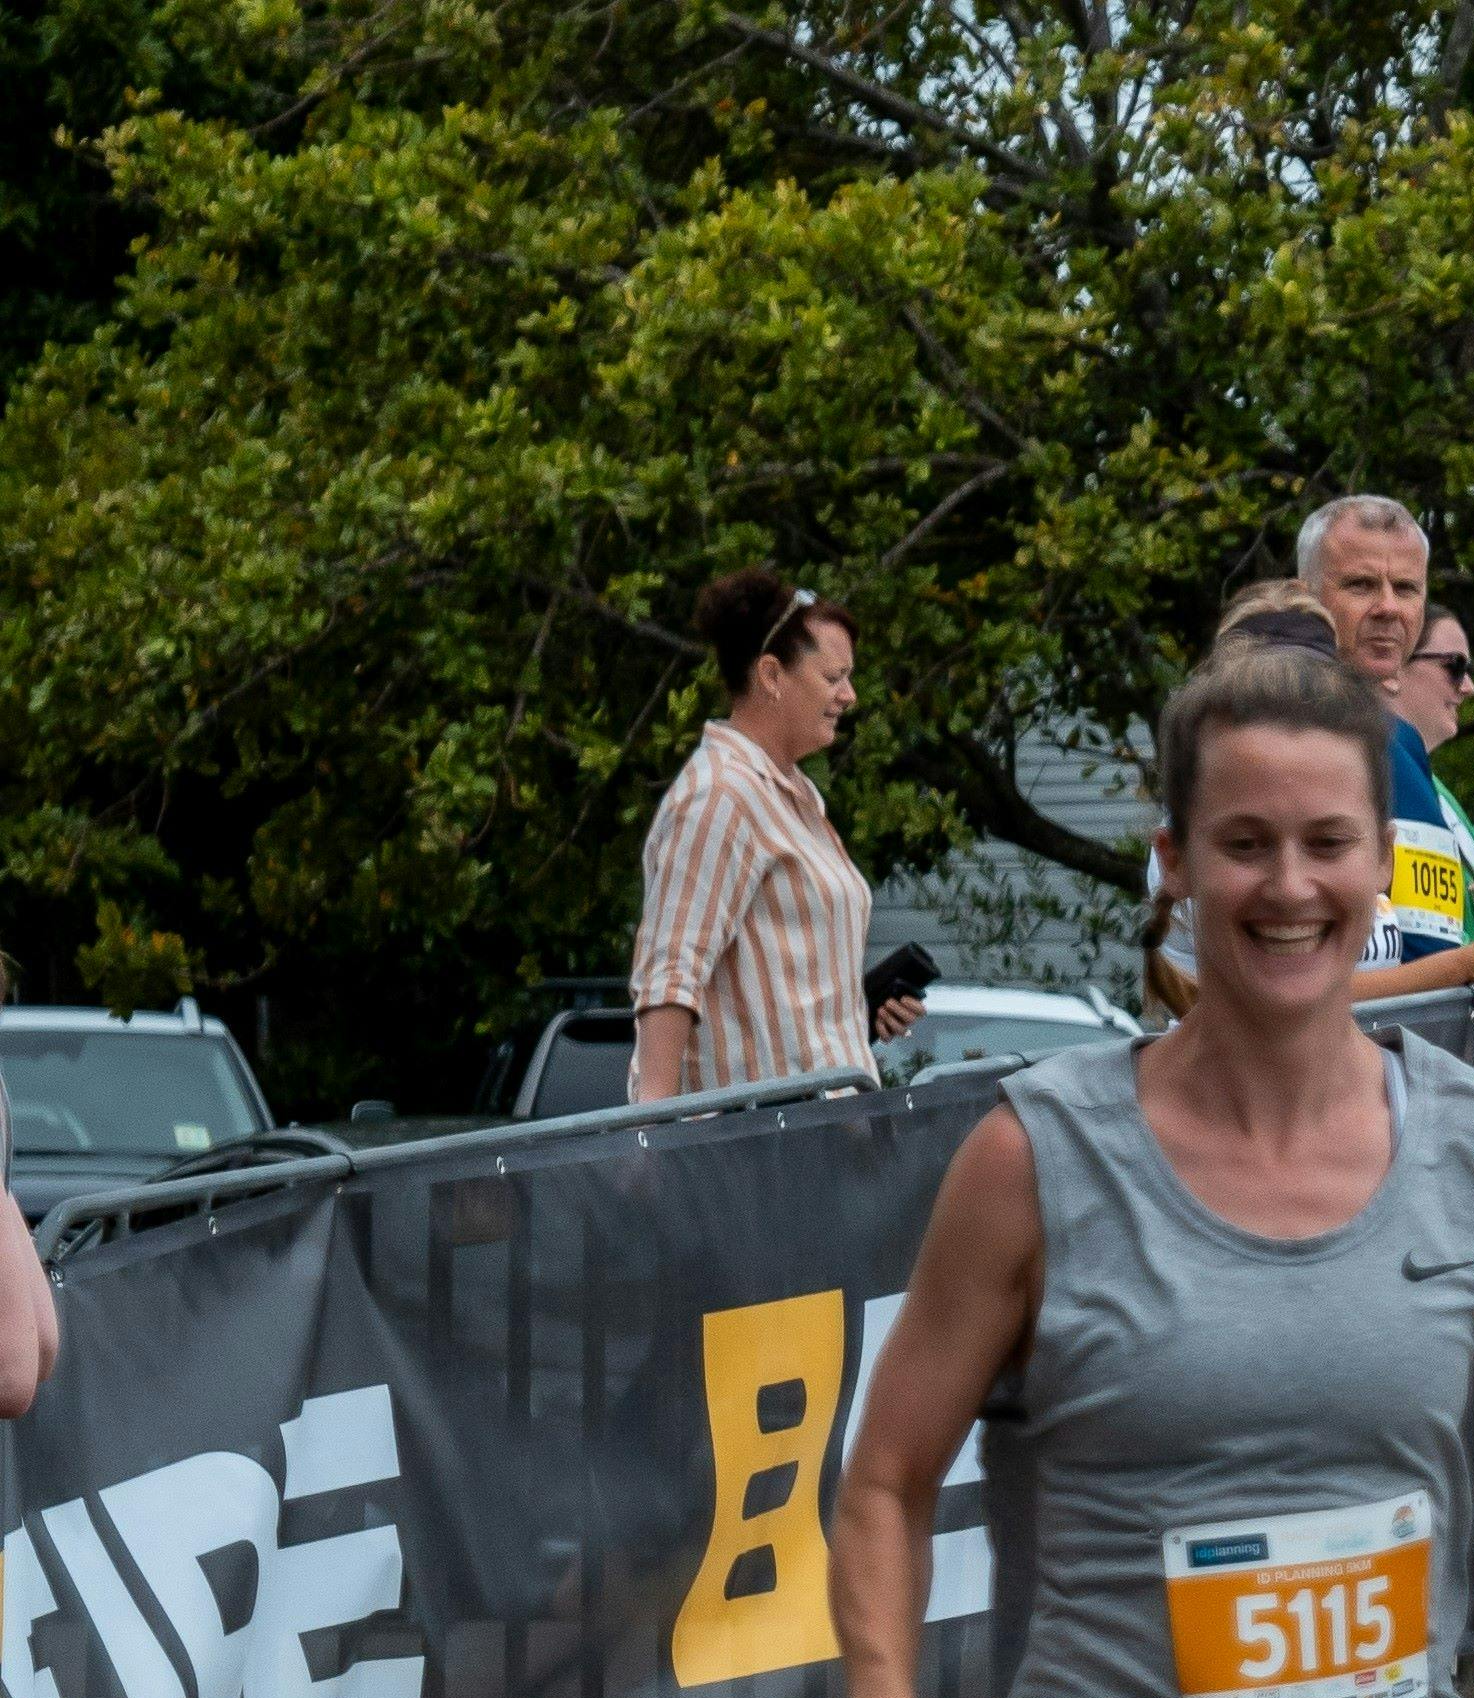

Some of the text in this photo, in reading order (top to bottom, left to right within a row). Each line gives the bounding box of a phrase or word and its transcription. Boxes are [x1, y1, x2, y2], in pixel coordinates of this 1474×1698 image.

[1412, 860, 1458, 904] 10155
[1274, 1563, 1344, 1583] PLANNING
[1236, 1574, 1393, 1680] 5115
